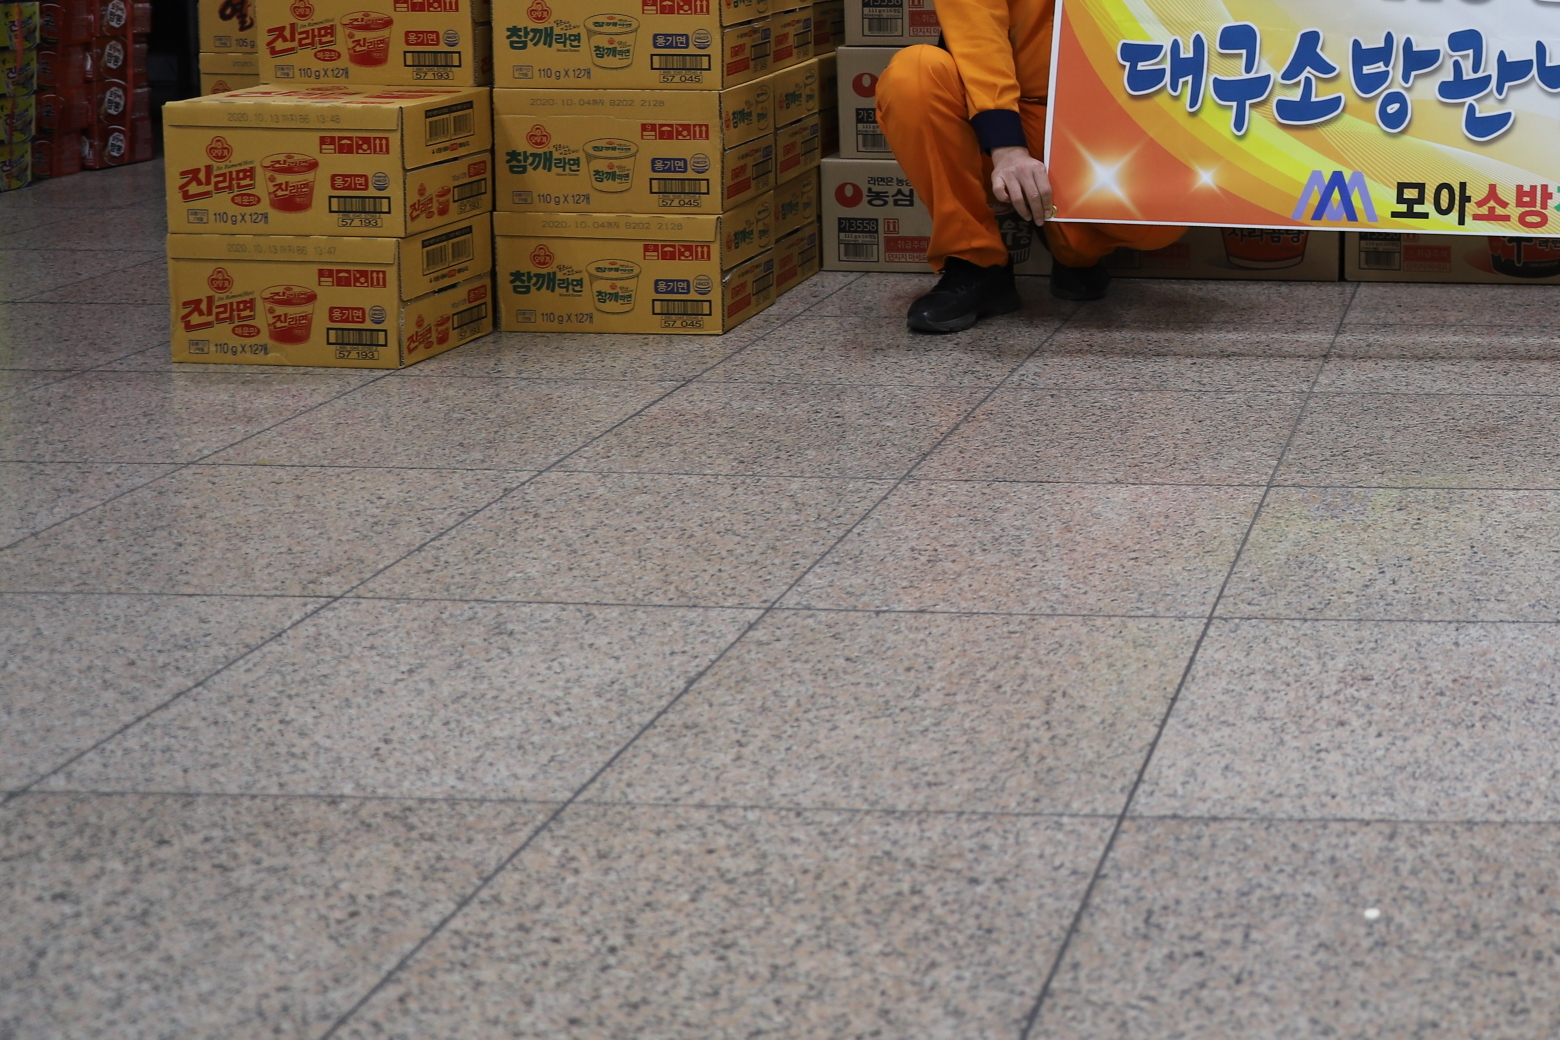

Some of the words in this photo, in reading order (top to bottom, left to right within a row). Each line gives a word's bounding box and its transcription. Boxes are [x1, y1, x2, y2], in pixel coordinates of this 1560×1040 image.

[179, 165, 255, 202] 진라면
[333, 177, 366, 188] 용기면
[840, 218, 877, 231] 가3558
[509, 270, 584, 295] 참깨라면
[657, 281, 688, 292] 용기면
[181, 296, 255, 331] 진라면
[332, 309, 363, 321] 용기면
